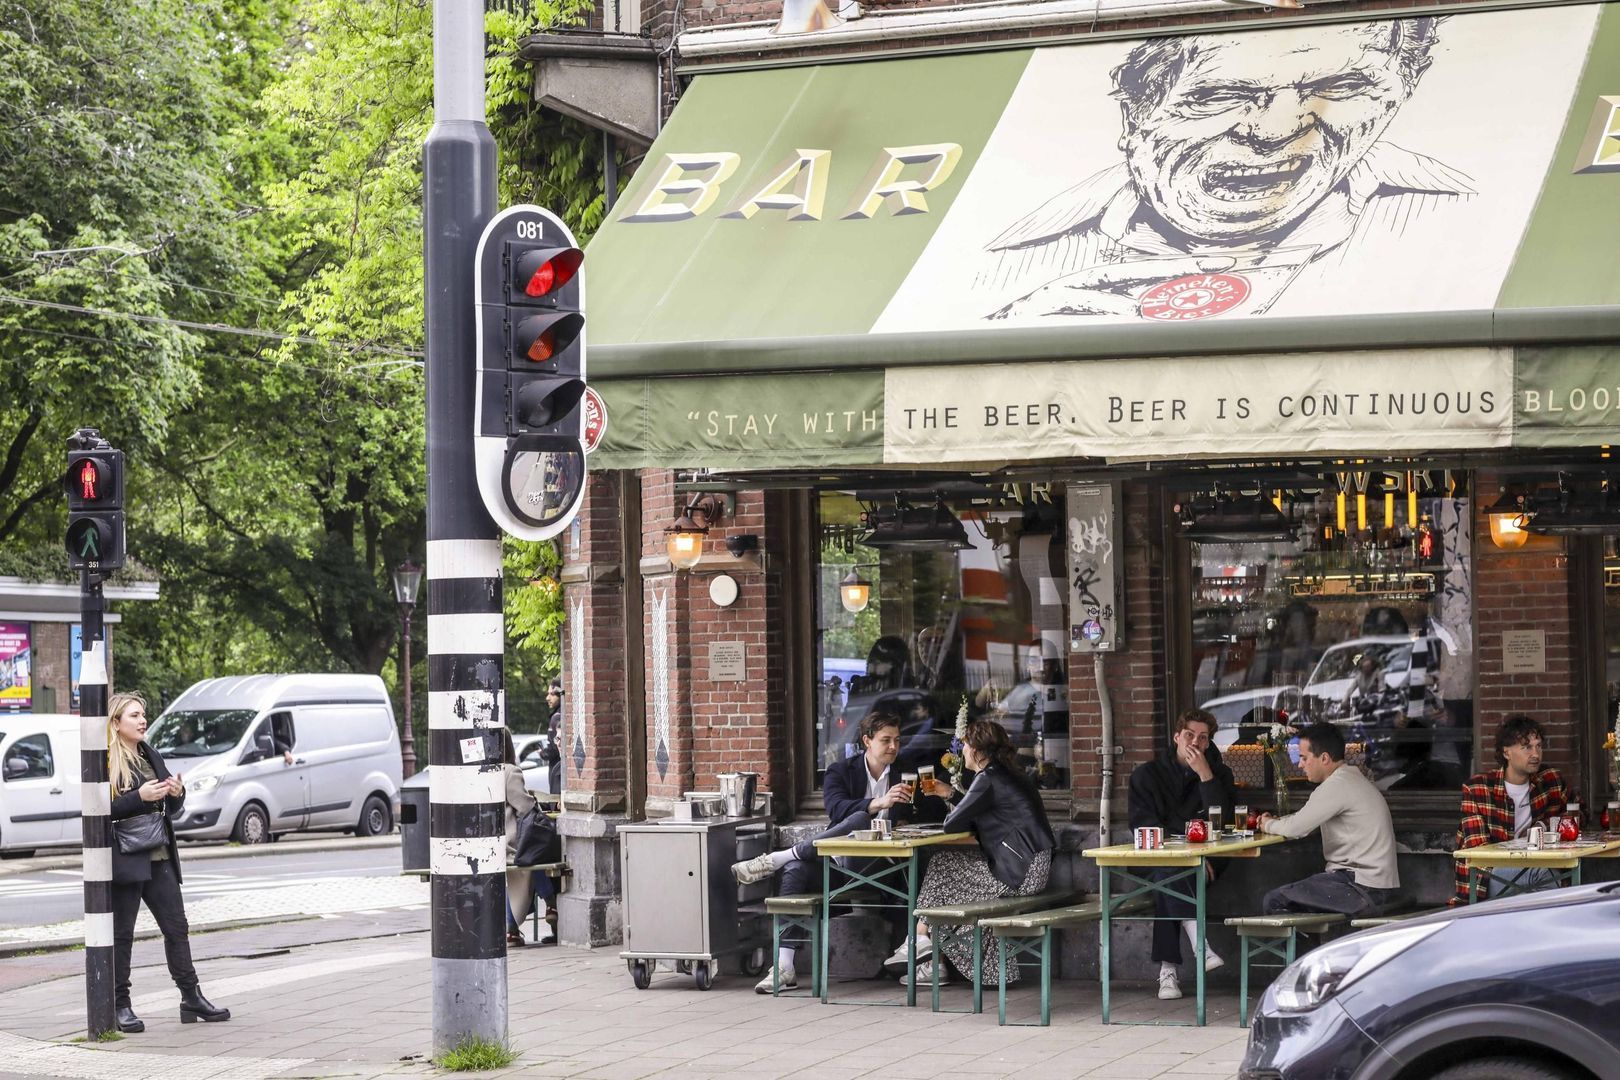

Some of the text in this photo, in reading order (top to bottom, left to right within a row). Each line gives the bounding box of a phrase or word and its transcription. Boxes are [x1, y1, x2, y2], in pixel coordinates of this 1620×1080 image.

[617, 143, 963, 223] BAR
[516, 220, 544, 240] 081
[1143, 275, 1239, 308] Heineken's
[1154, 308, 1213, 319] Bier
[803, 410, 877, 434] WITH
[904, 406, 959, 430] THE
[984, 402, 1078, 428] BEER.
[1107, 395, 1187, 423] BEER
[1216, 396, 1251, 420] IS
[1278, 389, 1495, 419] CONTINUOUS
[1524, 386, 1620, 412] BLOO
[88, 561, 99, 569] 351
